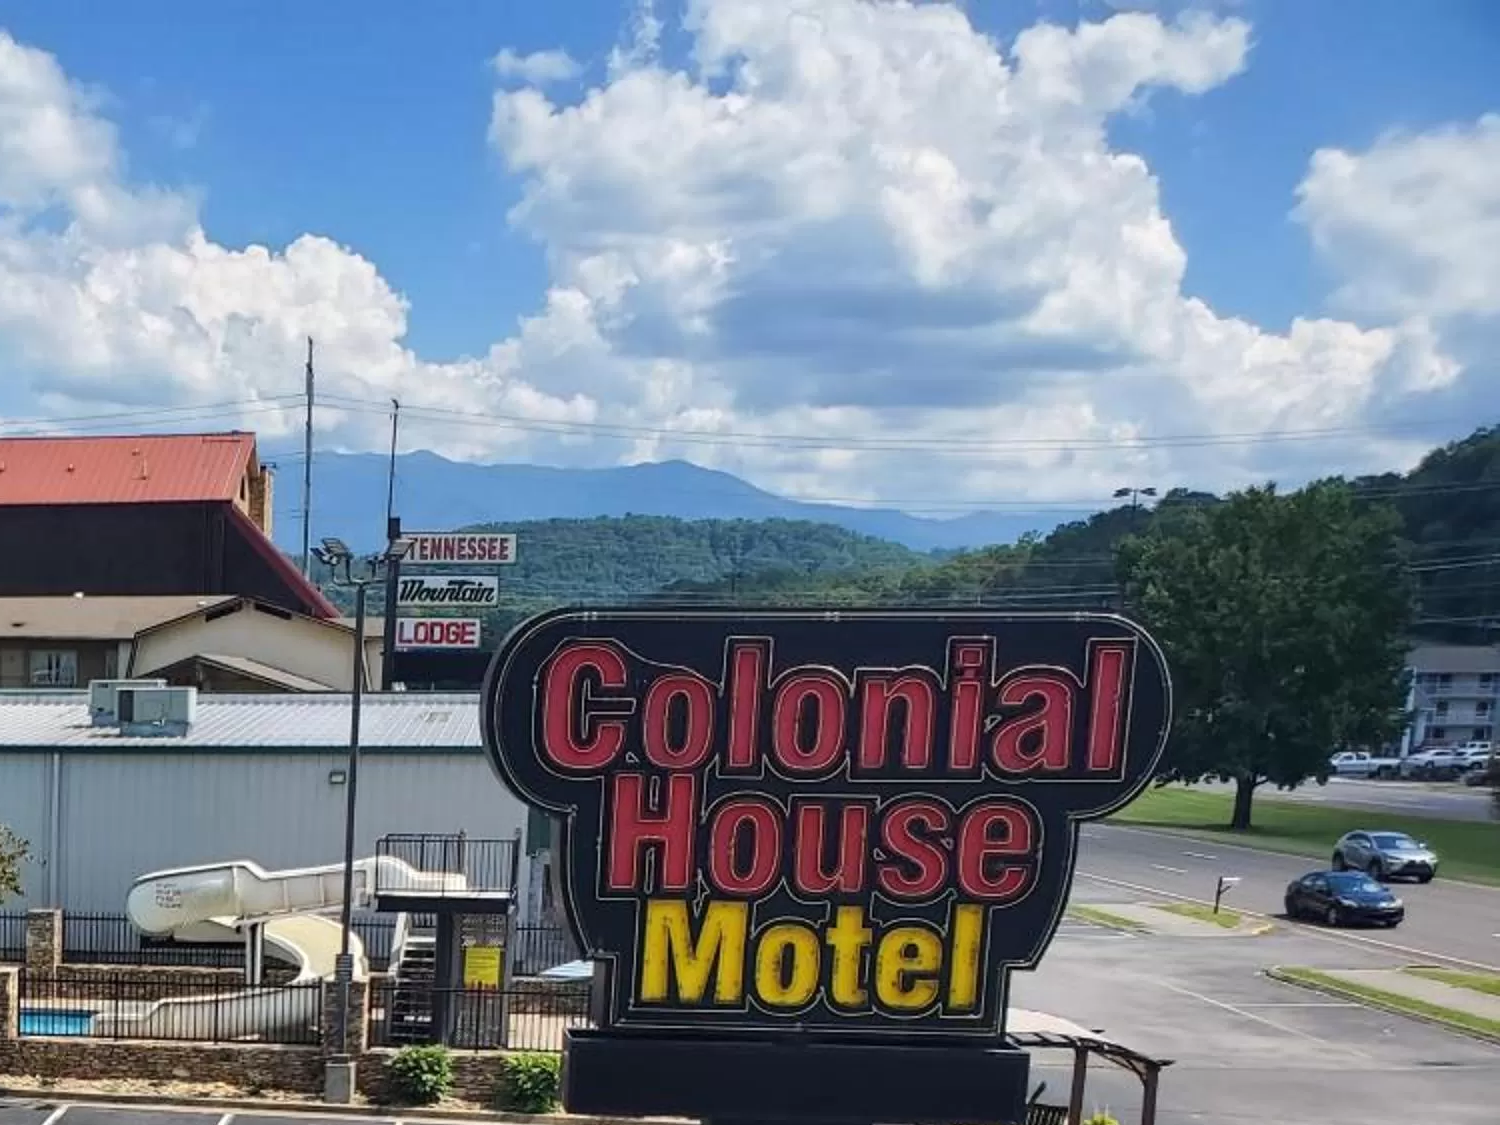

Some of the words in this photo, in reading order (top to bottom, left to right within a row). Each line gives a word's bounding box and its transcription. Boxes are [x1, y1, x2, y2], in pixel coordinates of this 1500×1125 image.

[406, 537, 509, 561] TENNESSEE
[398, 621, 477, 645] LODGE
[542, 641, 1128, 773] Colonial
[607, 773, 1032, 897] House
[640, 900, 985, 1010] Motel
